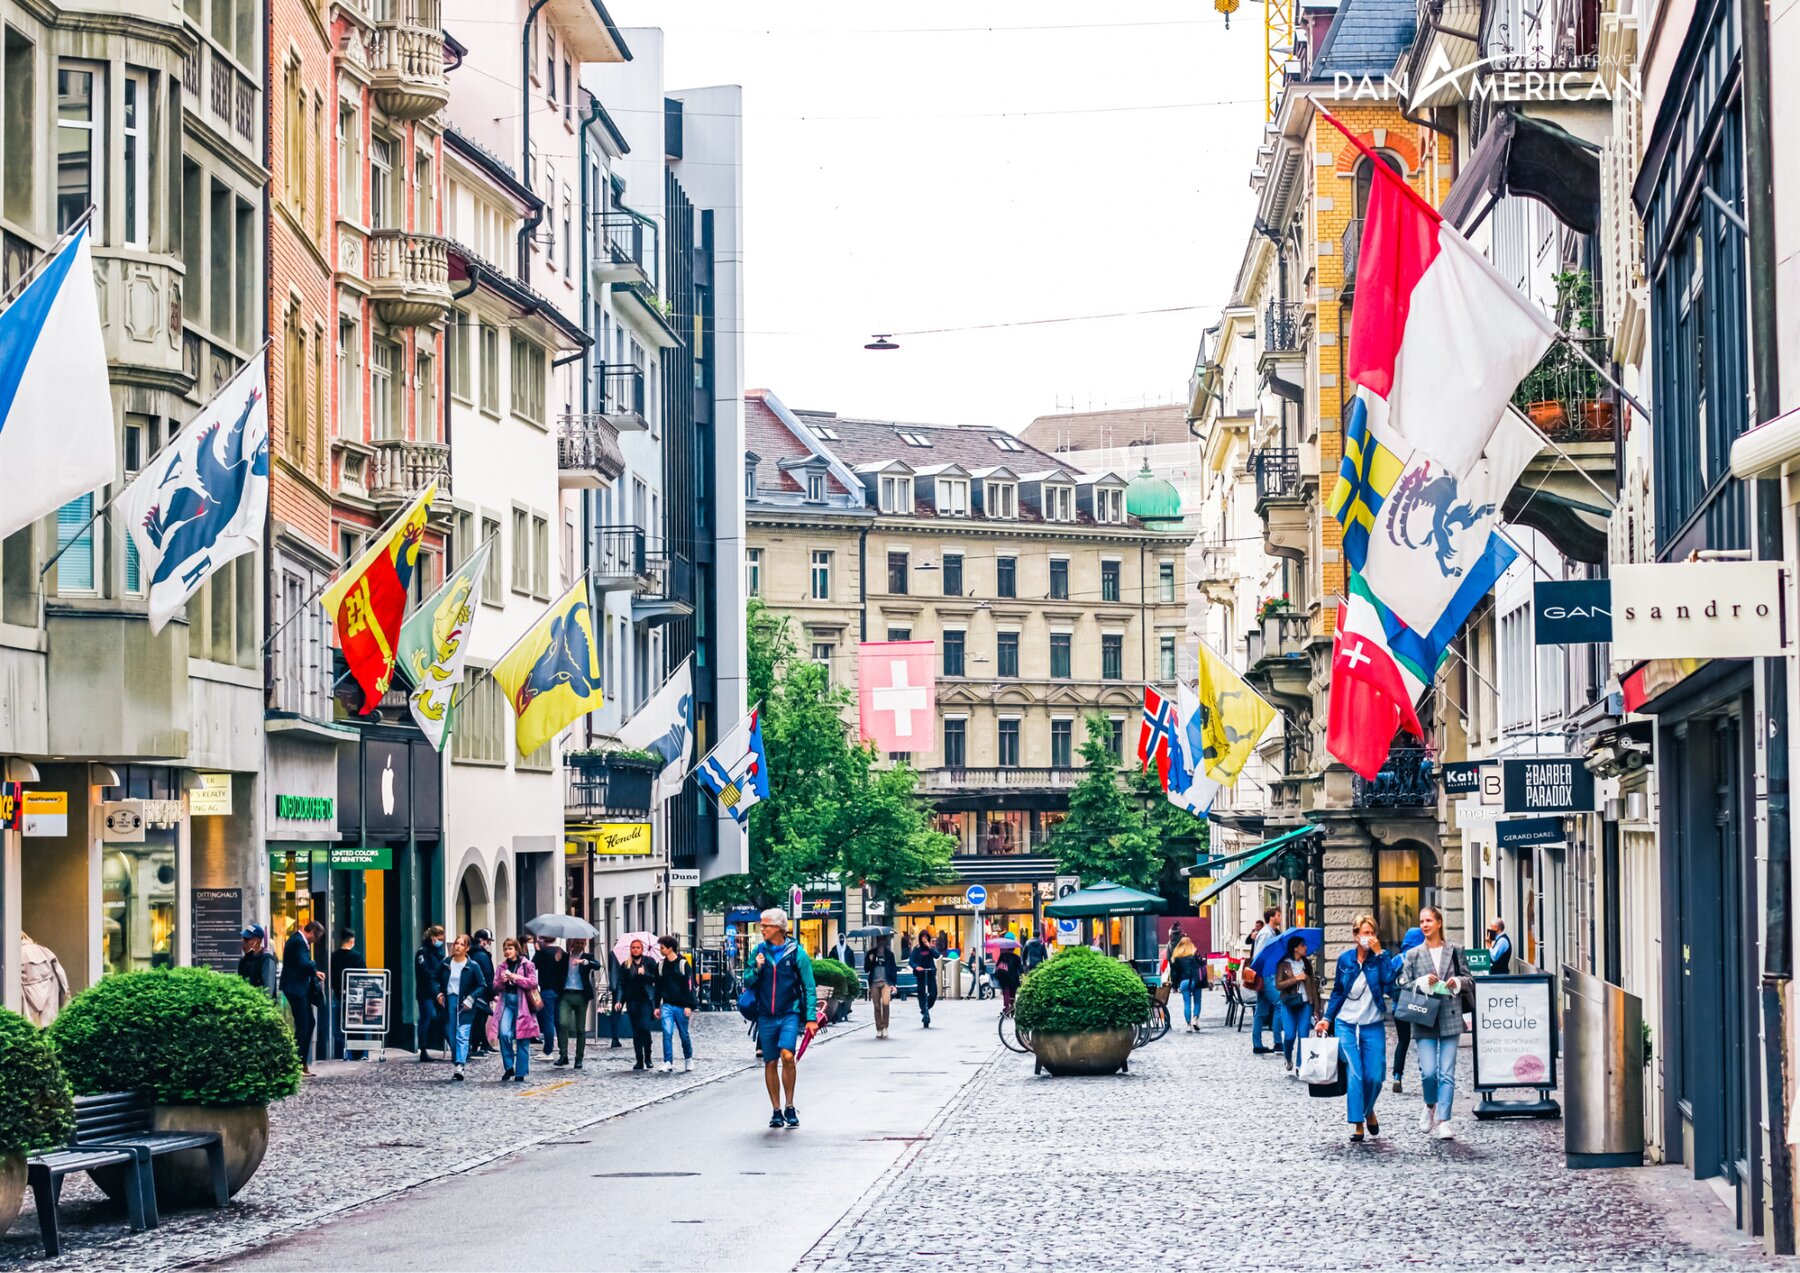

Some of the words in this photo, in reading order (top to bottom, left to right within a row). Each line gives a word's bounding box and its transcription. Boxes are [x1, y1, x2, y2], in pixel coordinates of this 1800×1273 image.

[1625, 600, 1769, 620] sandro
[1533, 764, 1572, 785] BARBER
[1526, 786, 1572, 807] PARADOX
[604, 826, 642, 849] Honold
[1503, 833, 1532, 841] GERARD
[1407, 1003, 1428, 1014] ecco
[1488, 994, 1519, 1012] pret
[1482, 1013, 1537, 1030] beaute
